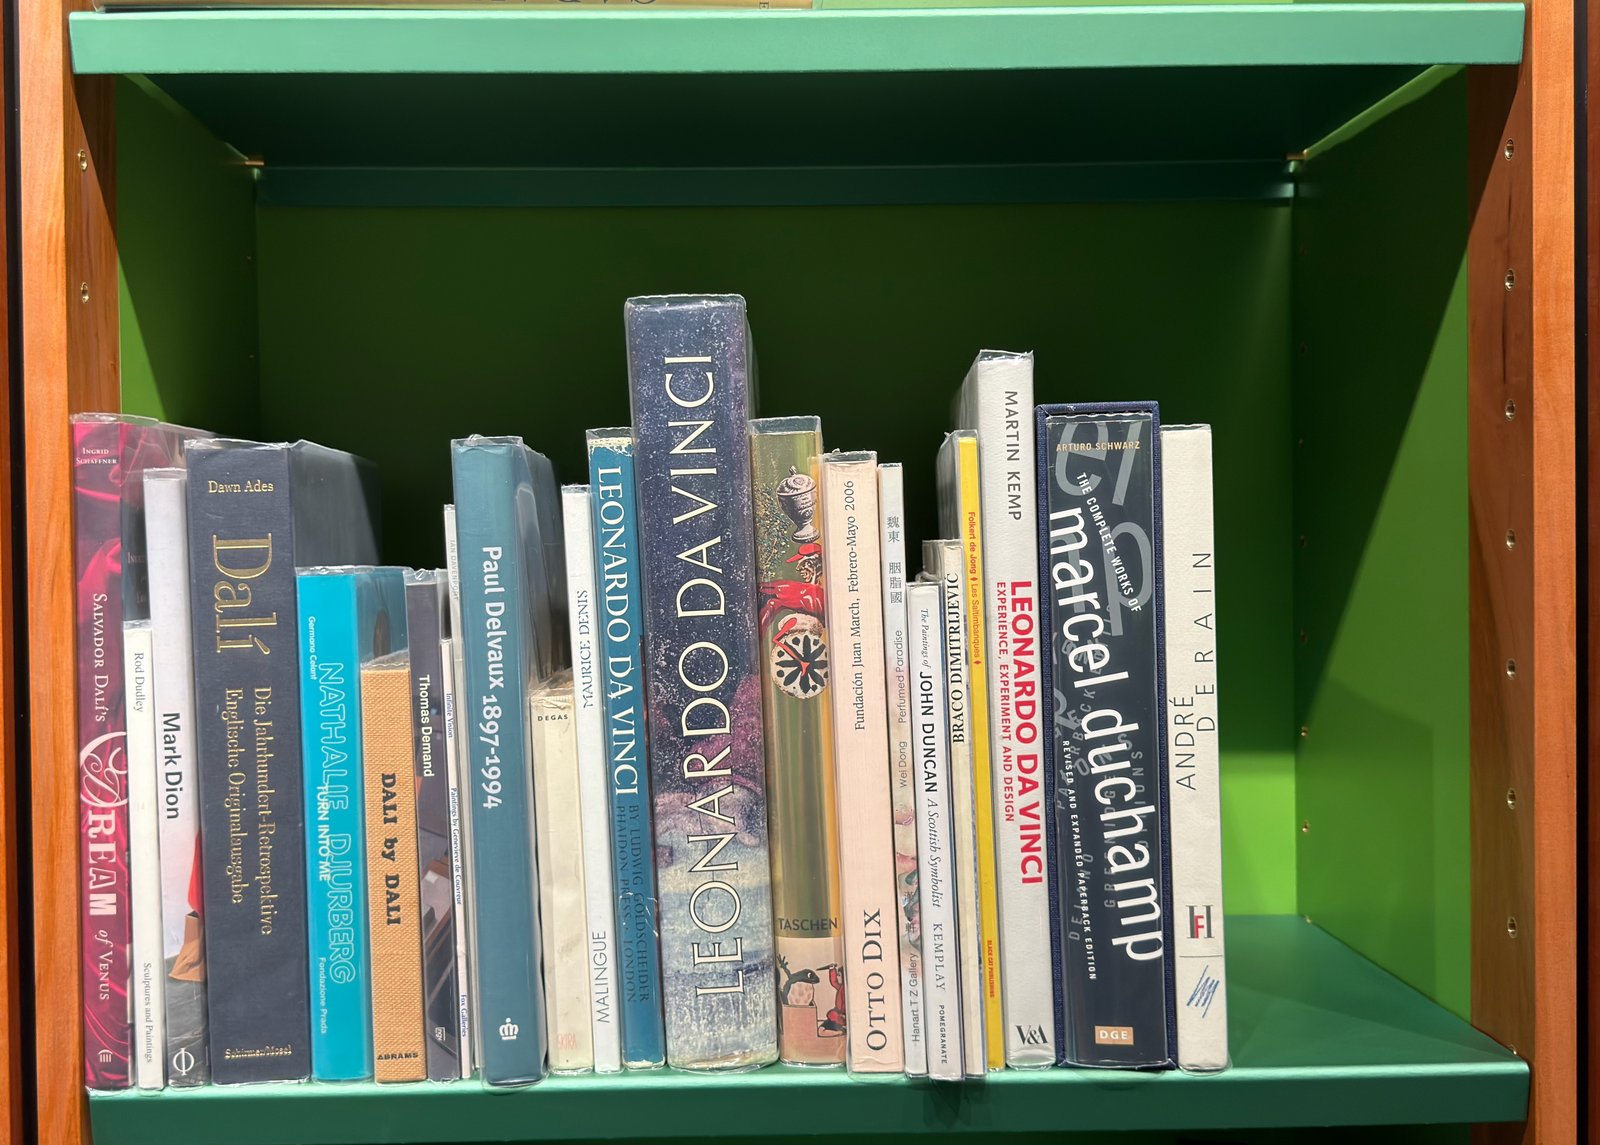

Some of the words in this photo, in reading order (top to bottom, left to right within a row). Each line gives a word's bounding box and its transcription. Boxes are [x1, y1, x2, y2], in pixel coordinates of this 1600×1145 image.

[664, 355, 718, 526] VINCI
[1005, 391, 1020, 461] MARTIN
[1056, 442, 1092, 452] ARTURO
[1095, 441, 1140, 451] SCHWARZ
[208, 480, 241, 493] Dawn
[244, 480, 274, 493] Ades
[844, 480, 855, 511] 2006
[1007, 471, 1022, 520] KEMP
[968, 511, 977, 540] Folkert
[969, 542, 976, 553] de
[1077, 472, 1093, 495] THE
[1086, 497, 1118, 555] COMPLETE
[1110, 556, 1134, 596] WORKS
[1128, 598, 1142, 612] OF
[482, 546, 506, 594] Paul
[598, 466, 631, 643] LEONARDO
[675, 535, 725, 619] DA
[846, 516, 859, 593] Febrero-Mayo
[969, 554, 977, 575] Jong
[213, 533, 278, 655] Dalí
[576, 590, 590, 635] DENIS
[920, 608, 929, 623] The
[1050, 507, 1129, 688] marcel
[92, 593, 108, 668] SALVADOR
[308, 616, 317, 654] Germano
[921, 624, 931, 658] Paintings
[971, 600, 981, 658] Saltimbanques
[997, 582, 1009, 660] EXPERIENCE,
[1192, 553, 1215, 731] DERAIN
[134, 652, 145, 673] Rod
[309, 654, 318, 681] Celant
[484, 602, 508, 689] Delvaux
[852, 642, 864, 668] Juan
[894, 630, 904, 673] Paradise
[922, 660, 932, 668] of
[1010, 580, 1038, 744] LEONARDO
[134, 676, 146, 713] Dudley
[578, 640, 594, 709] MAURICE
[608, 656, 634, 700] DA
[919, 671, 934, 716] JOHN
[254, 687, 272, 715] Die
[419, 674, 431, 724] Thomas
[537, 713, 568, 722] DEGAS
[852, 672, 865, 731] Fundación
[896, 675, 907, 723] Perfumed
[951, 689, 965, 743] BRACO
[999, 664, 1012, 741] EXPERIMENT
[162, 712, 182, 766] Mark
[221, 687, 246, 768] Englische
[318, 662, 349, 810] NATHALIE
[421, 726, 435, 777] Demand
[611, 706, 638, 795] VINCI
[1169, 696, 1196, 791] ANDRÉ
[478, 694, 503, 810] 1897-1994
[898, 741, 907, 767] Dong
[922, 723, 938, 793] DUNCAN
[1002, 746, 1013, 772] AND
[1016, 754, 1039, 796] DA
[1062, 740, 1074, 784] REVISED
[165, 771, 183, 819] Dion
[381, 772, 398, 825] DALI
[899, 770, 907, 788] Wei
[927, 798, 938, 808] A
[1003, 778, 1014, 822] DESIGN
[1067, 789, 1077, 809] AND
[253, 719, 279, 936] Jahrhundert-Retrospektive
[316, 786, 329, 821] TURN
[452, 818, 458, 827] by
[628, 805, 640, 820] BY
[678, 641, 745, 998] LEONARDO
[223, 772, 249, 904] Originalausgabe
[317, 824, 331, 858] INTO
[381, 837, 399, 861] by
[616, 805, 629, 872] PHAIDON
[928, 810, 941, 855] Scottish
[1018, 801, 1043, 884] VINCI
[1070, 814, 1084, 867] EXPANDED
[1081, 709, 1163, 961] duchamp
[318, 860, 332, 882] ME
[630, 829, 644, 885] LUDWIG
[385, 873, 401, 926] DALI
[620, 879, 632, 919] PRESS
[928, 856, 944, 908] Symbolist
[1077, 872, 1092, 933] PAPERBACK
[327, 833, 356, 984] DJURBERG
[778, 917, 838, 932] TASCHEN
[94, 929, 113, 948] of
[634, 892, 650, 1002] GOLDSCHEIDER
[862, 908, 883, 963] DIX
[932, 923, 946, 992] KEMPLAY
[1084, 937, 1097, 980] EDITION
[99, 950, 113, 1001] VENUS
[142, 962, 152, 1004] Sculptures
[318, 957, 328, 1006] Fondazione
[592, 931, 610, 1023] MALINGUE
[623, 940, 637, 1003] LONDON
[908, 953, 919, 988] Gallery
[145, 1005, 153, 1023] and
[320, 1008, 329, 1034] Prada
[461, 1007, 469, 1037] Galleries
[866, 972, 887, 1051] OTTO
[911, 1009, 921, 1042] Hanart
[938, 1004, 948, 1064] POMEGRANATE
[1016, 1024, 1049, 1045] V&A
[1099, 1030, 1129, 1040] DGE
[144, 1025, 154, 1063] Paintings
[376, 1053, 419, 1061] ABRAMS
